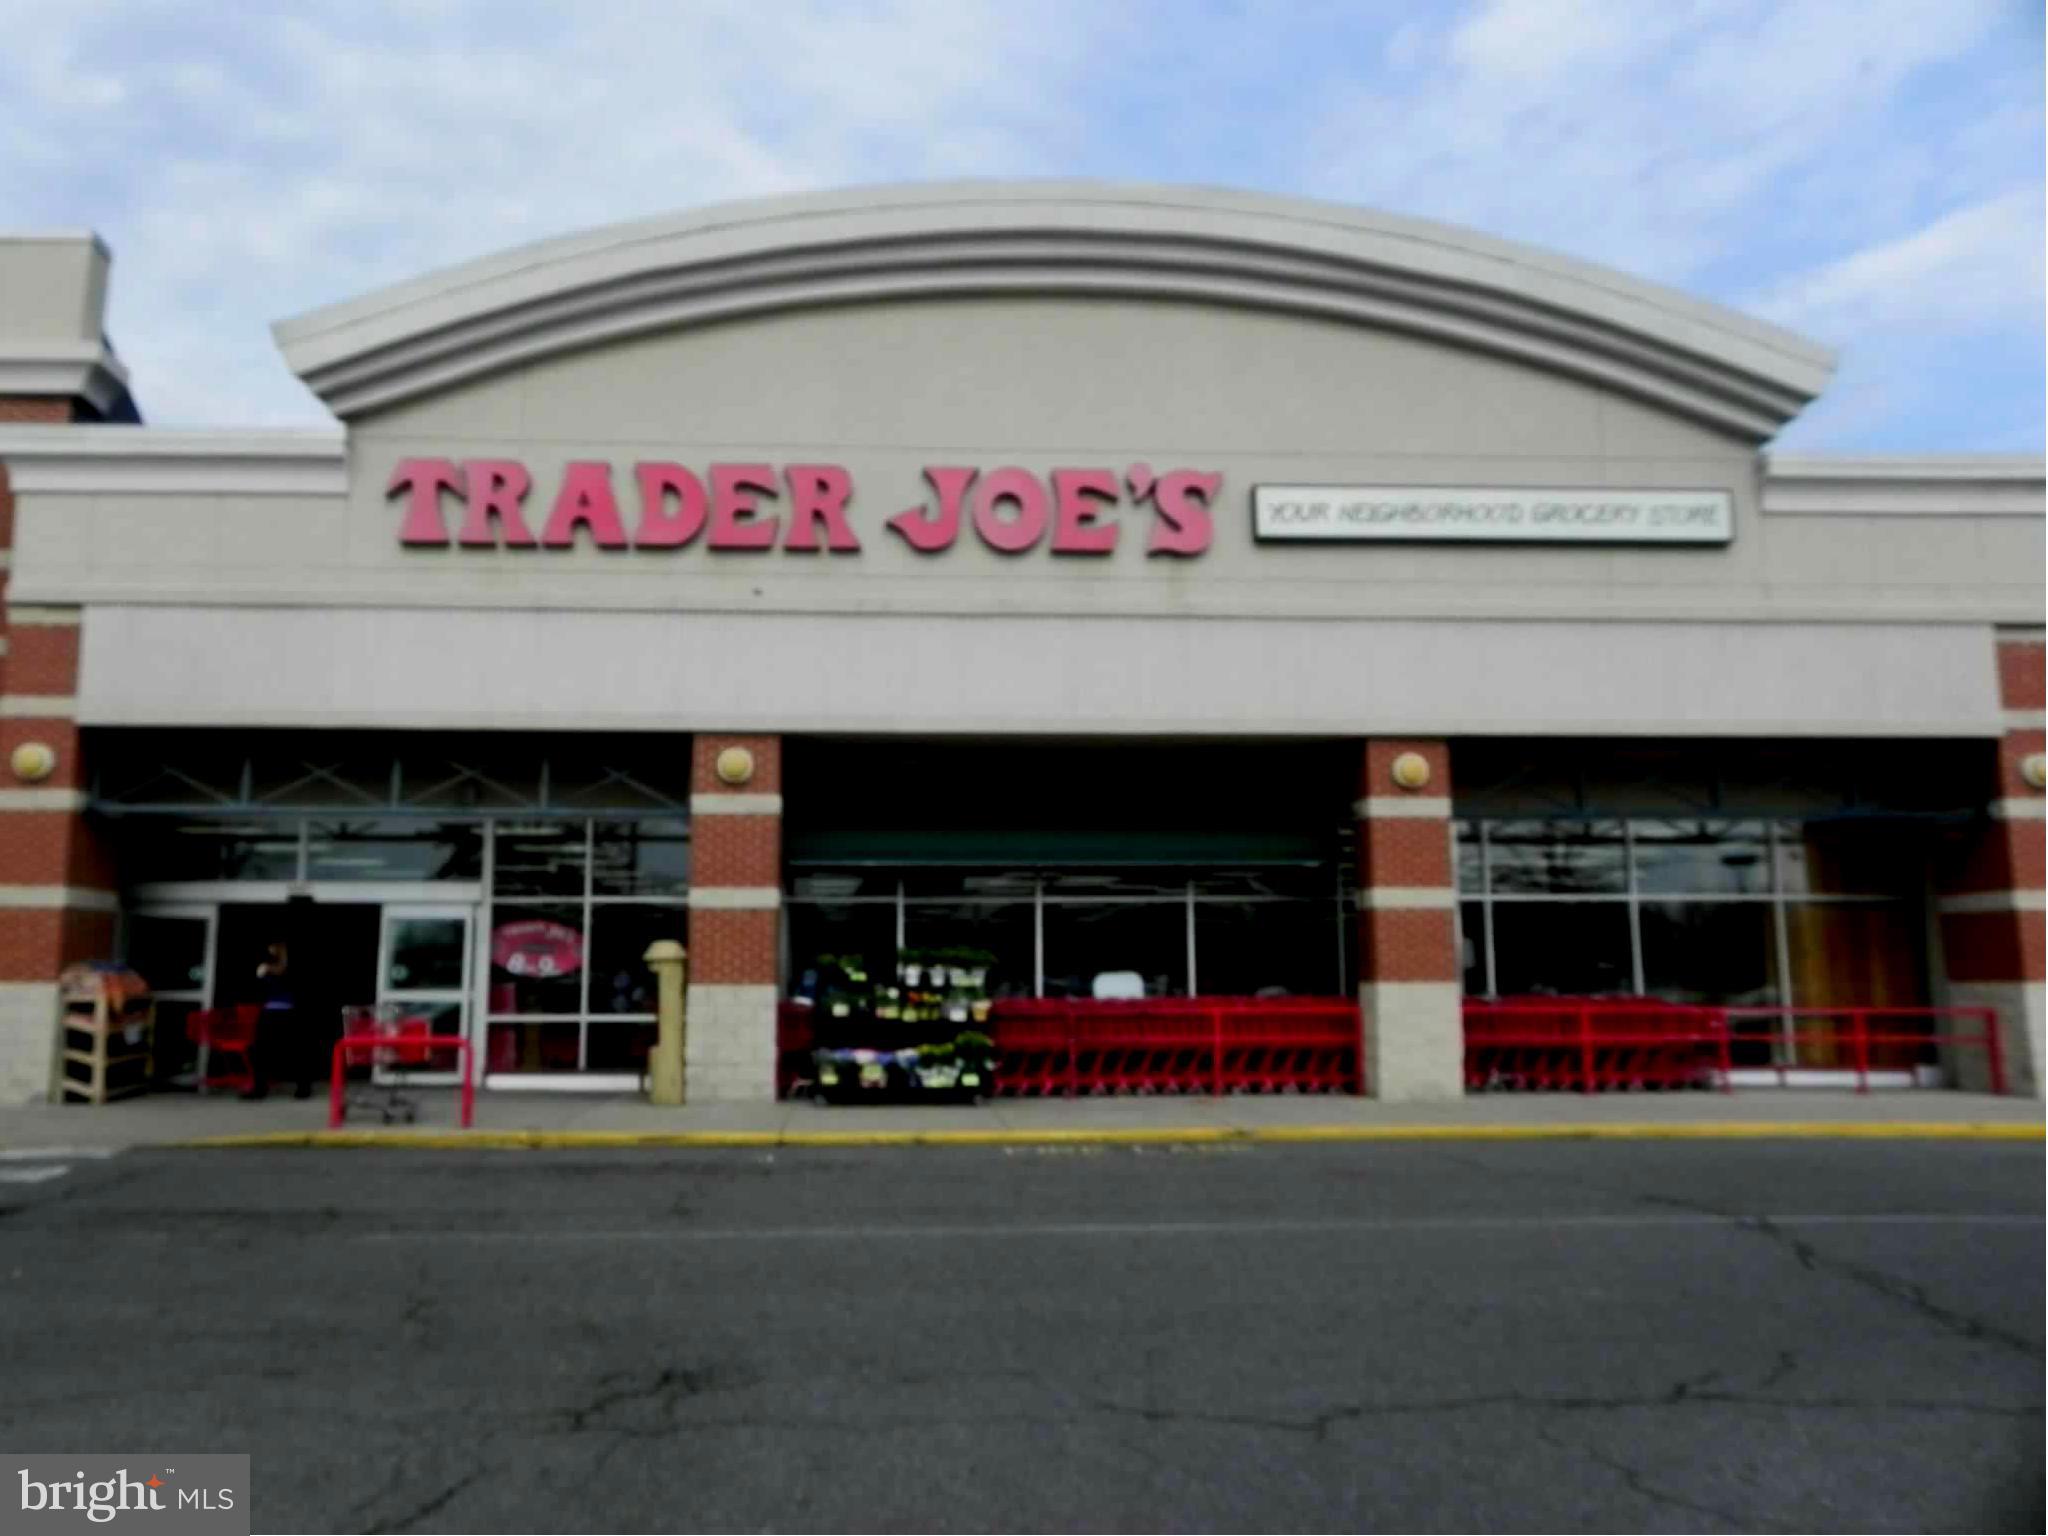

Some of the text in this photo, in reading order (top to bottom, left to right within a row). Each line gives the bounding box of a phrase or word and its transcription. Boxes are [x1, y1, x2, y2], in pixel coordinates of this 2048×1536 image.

[386, 457, 1224, 557] TRADER JOE'S
[1268, 502, 1329, 523] YOUR
